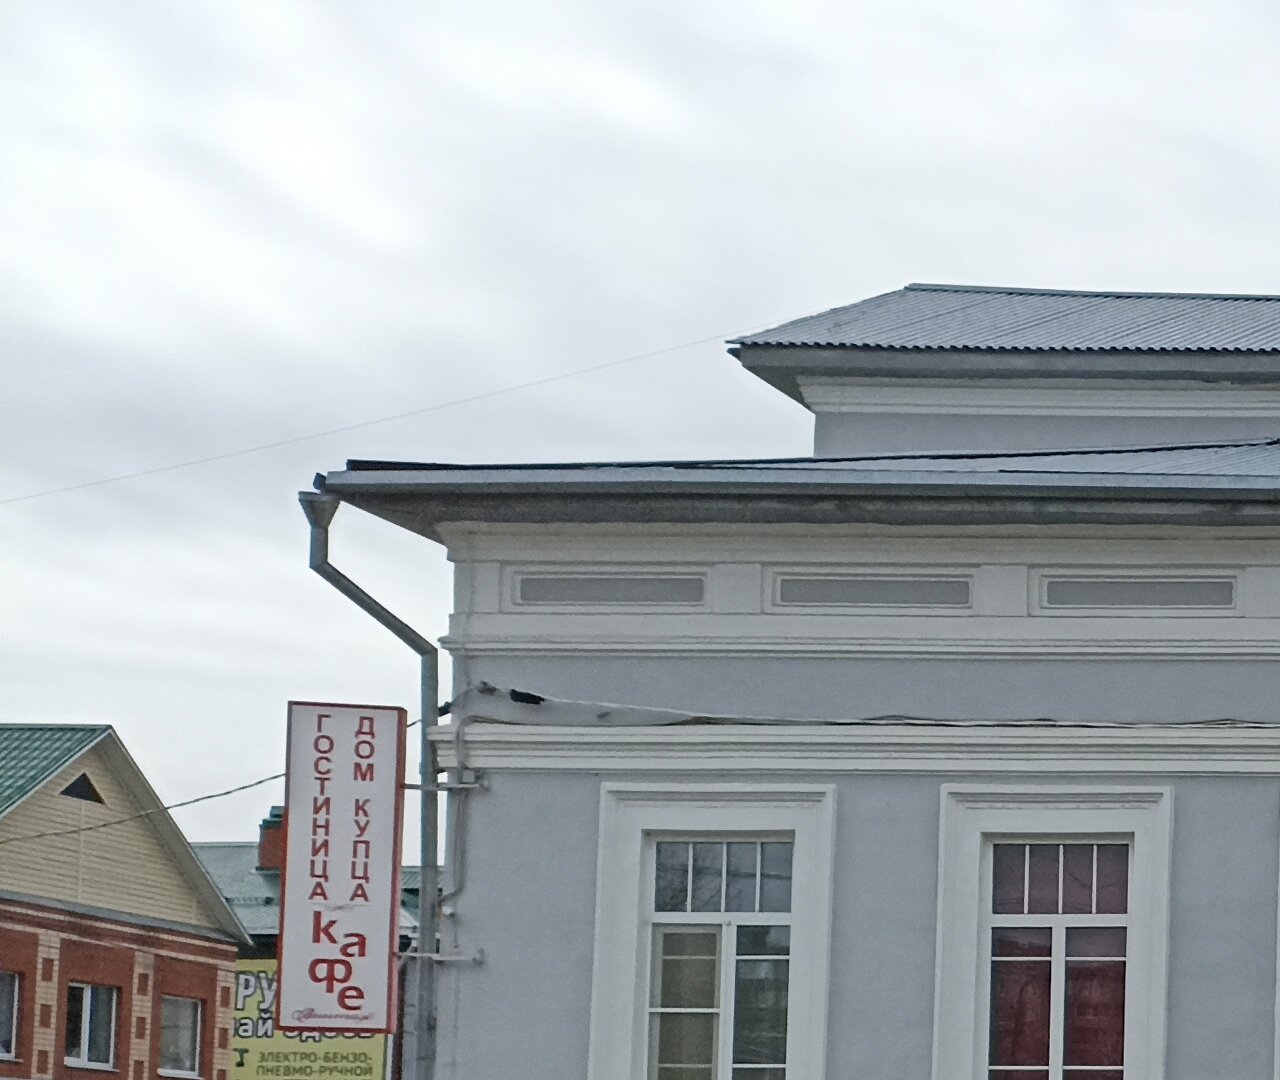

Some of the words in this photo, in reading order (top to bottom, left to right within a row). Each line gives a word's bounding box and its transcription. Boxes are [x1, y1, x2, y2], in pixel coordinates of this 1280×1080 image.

[353, 716, 375, 782] ДОМ
[308, 713, 335, 901] ГОСТИНИЦА
[349, 798, 371, 902] КУПЦА
[233, 1008, 274, 1038] ай
[255, 1063, 374, 1077] ПНЕВМО-РУЧНОЙ
